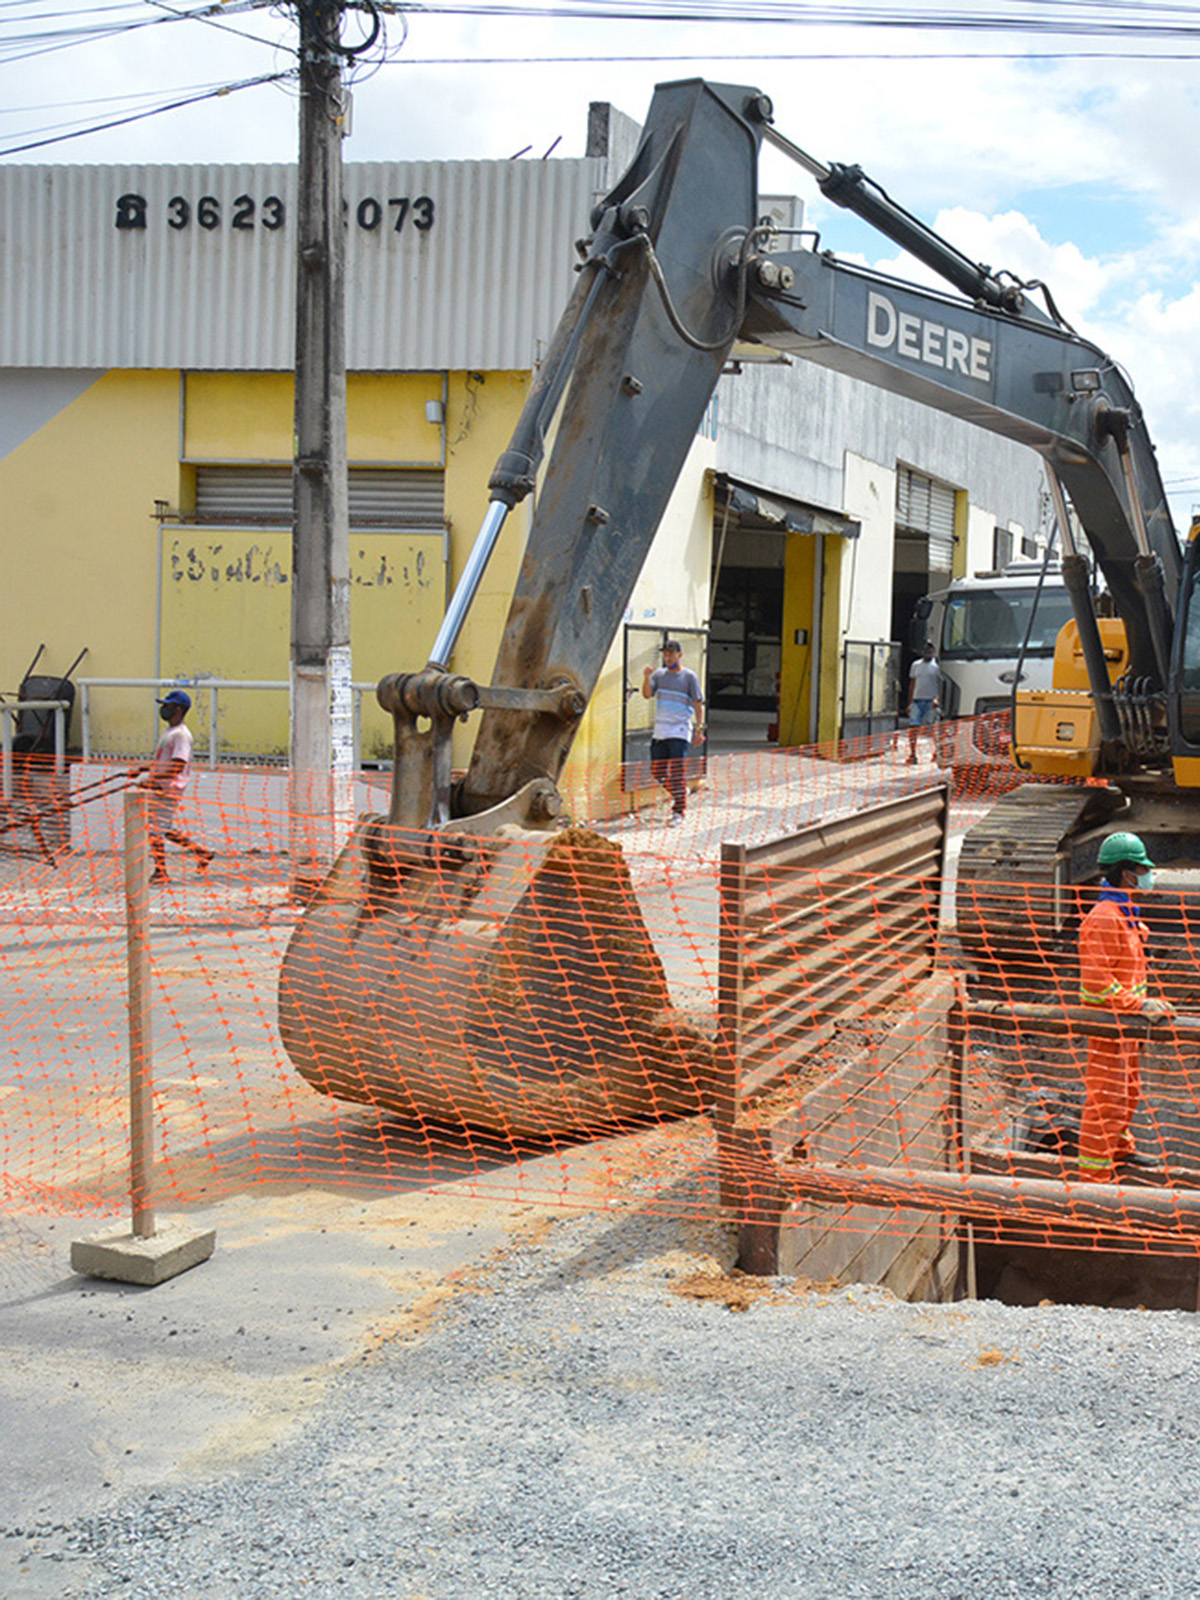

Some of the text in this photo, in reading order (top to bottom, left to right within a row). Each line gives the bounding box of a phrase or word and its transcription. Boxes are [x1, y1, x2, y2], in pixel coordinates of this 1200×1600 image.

[167, 196, 435, 232] 3623 073
[867, 290, 992, 382] DEERE
